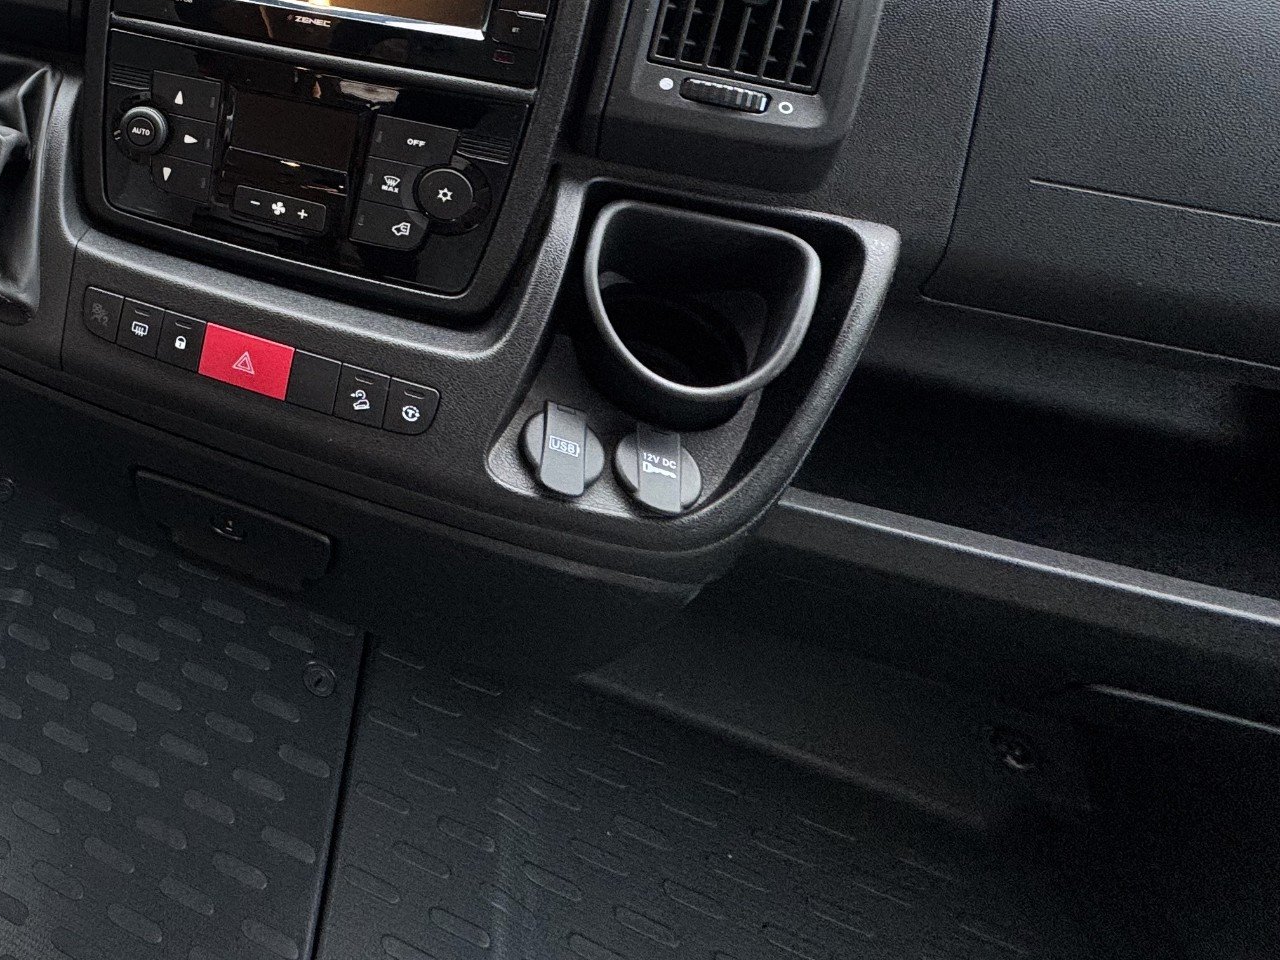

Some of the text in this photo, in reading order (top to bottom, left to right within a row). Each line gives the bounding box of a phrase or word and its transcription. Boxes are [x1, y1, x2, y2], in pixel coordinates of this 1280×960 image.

[294, 15, 332, 28] ZENEC
[131, 126, 151, 136] AUTO
[406, 138, 426, 147] OFF
[381, 184, 399, 194] MAX
[551, 438, 576, 454] USB
[642, 452, 677, 469] 12V DC
